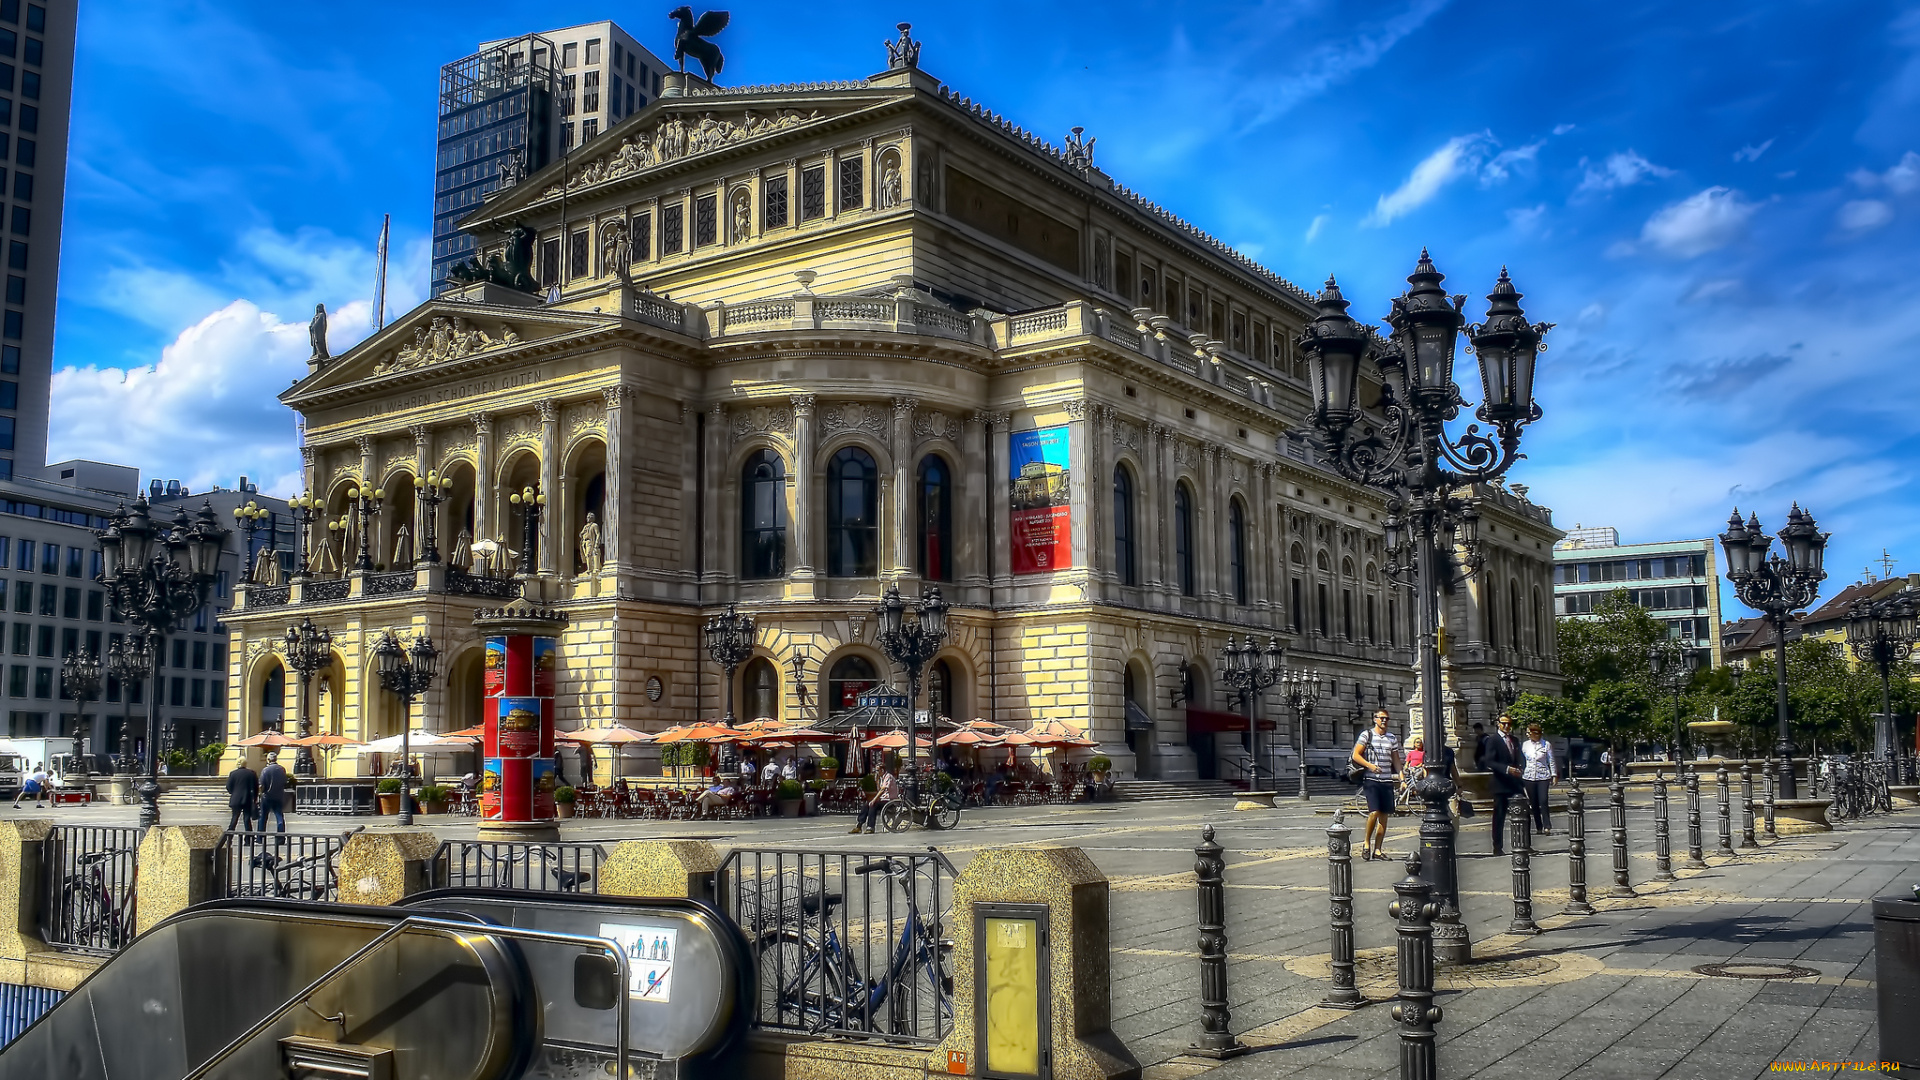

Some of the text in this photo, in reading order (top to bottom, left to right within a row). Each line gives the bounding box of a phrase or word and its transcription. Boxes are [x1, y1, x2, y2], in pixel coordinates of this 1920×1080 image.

[387, 393, 431, 413] WAHREN
[437, 380, 496, 401] SCHOENEN
[502, 369, 542, 389] GUTEN
